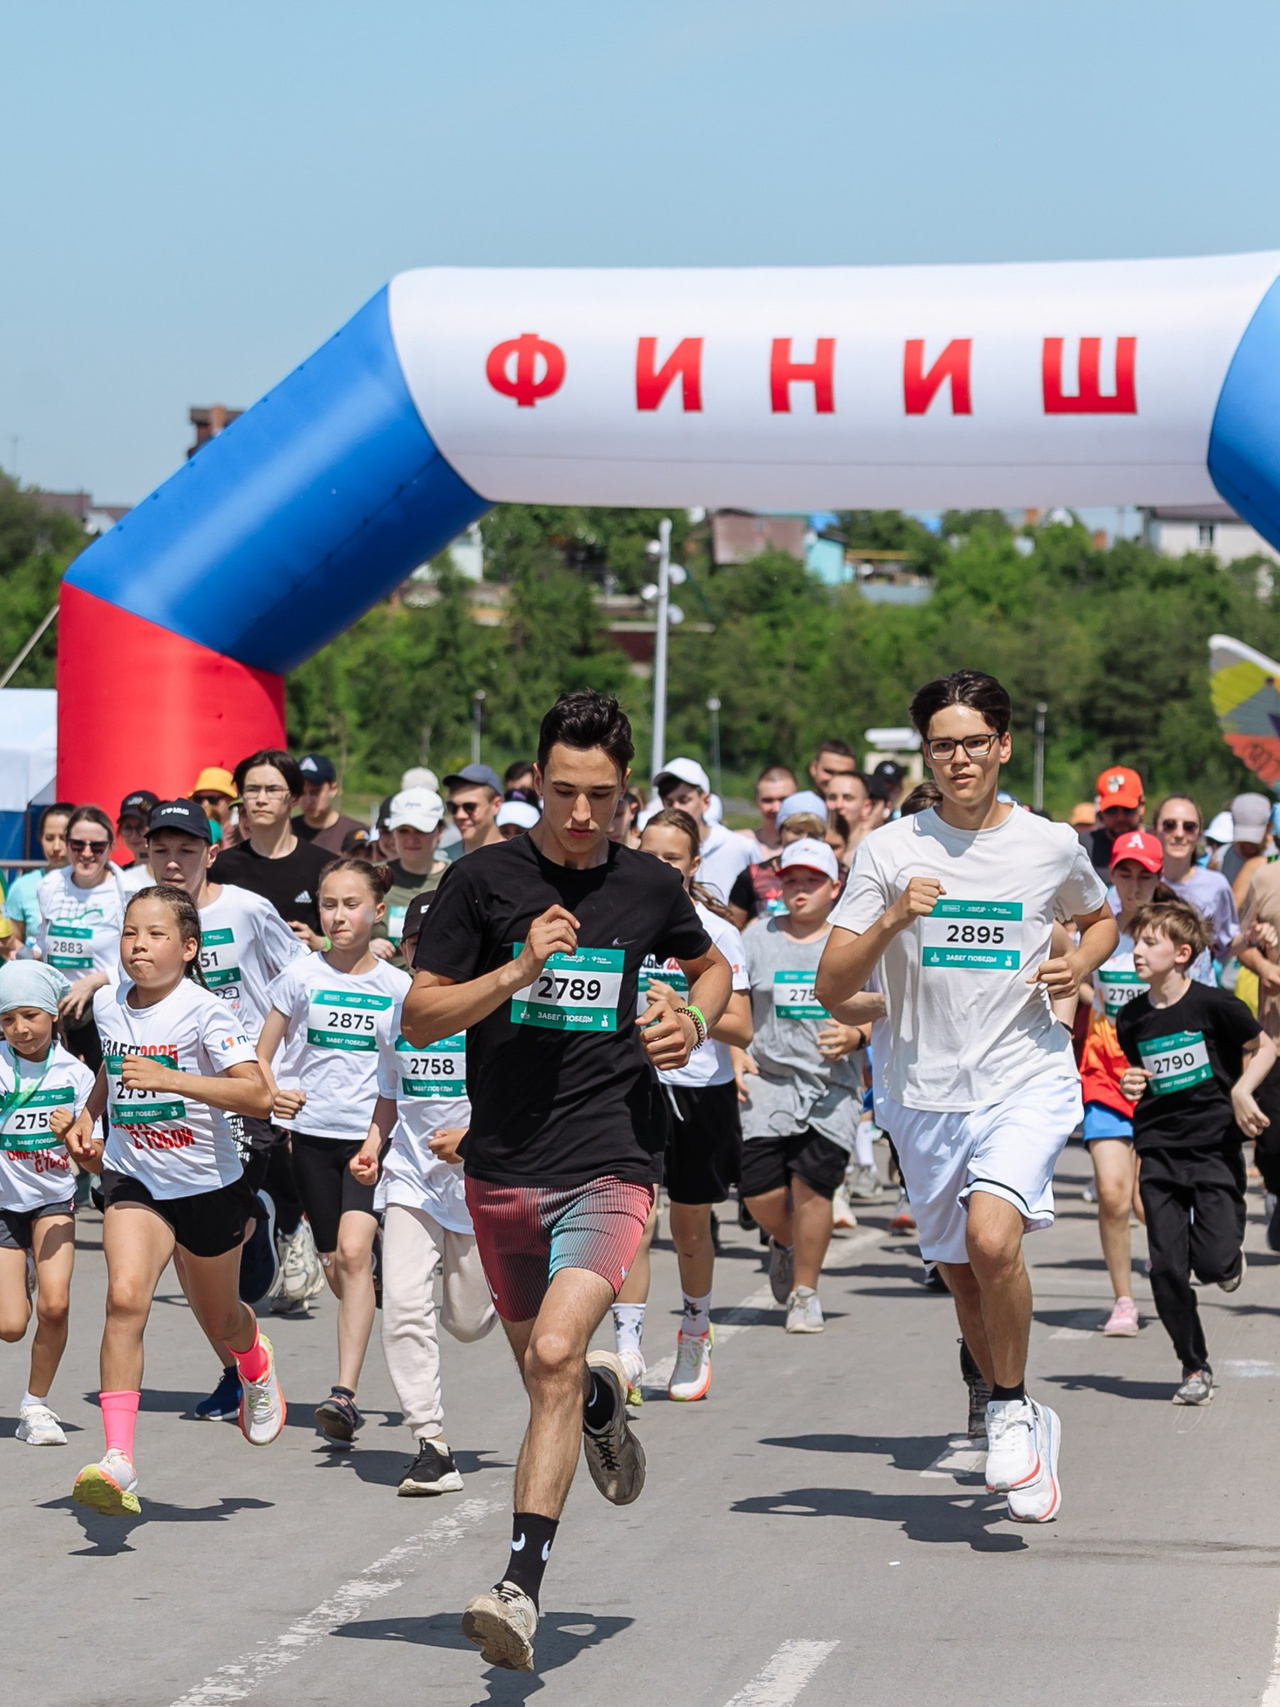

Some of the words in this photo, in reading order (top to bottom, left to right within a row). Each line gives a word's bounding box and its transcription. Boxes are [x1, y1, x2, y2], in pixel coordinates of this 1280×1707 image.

[486, 333, 1138, 416] ФИНИШ
[946, 924, 1005, 944] 2895
[53, 941, 83, 954] 2883
[968, 955, 997, 963] ПОБЕДЫ
[537, 976, 602, 1001] 2789
[327, 1011, 375, 1031] 2875
[537, 1011, 561, 1021] ЗАБЕГ
[563, 1014, 593, 1023] ПОБЕДЫ
[410, 1058, 455, 1075] 2758
[1153, 1052, 1195, 1075] 2790
[15, 1111, 54, 1130] 275
[143, 1126, 197, 1150] ТОБОЙ
